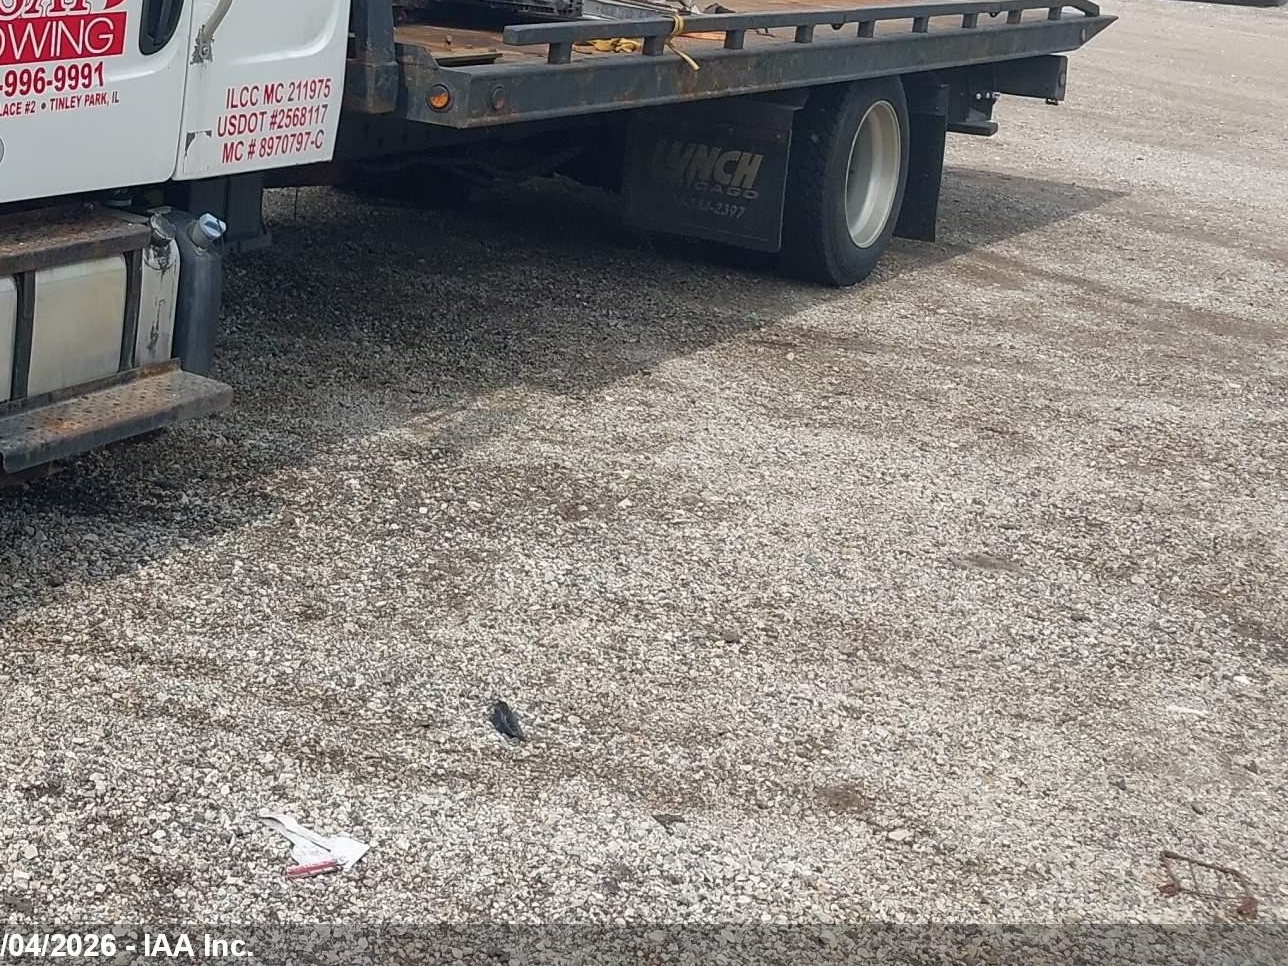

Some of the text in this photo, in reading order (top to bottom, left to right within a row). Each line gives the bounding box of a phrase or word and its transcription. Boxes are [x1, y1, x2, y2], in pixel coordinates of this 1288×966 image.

[24, 100, 36, 114] #2
[50, 94, 82, 112] TINLEY
[84, 92, 110, 108] PARK,
[112, 90, 120, 104] IL
[226, 78, 331, 109] ILCC MC 211975
[217, 104, 328, 137] USDOT #2568117
[222, 140, 244, 164] MC
[259, 129, 325, 158] 8970797-C
[650, 139, 764, 189] LYNCH
